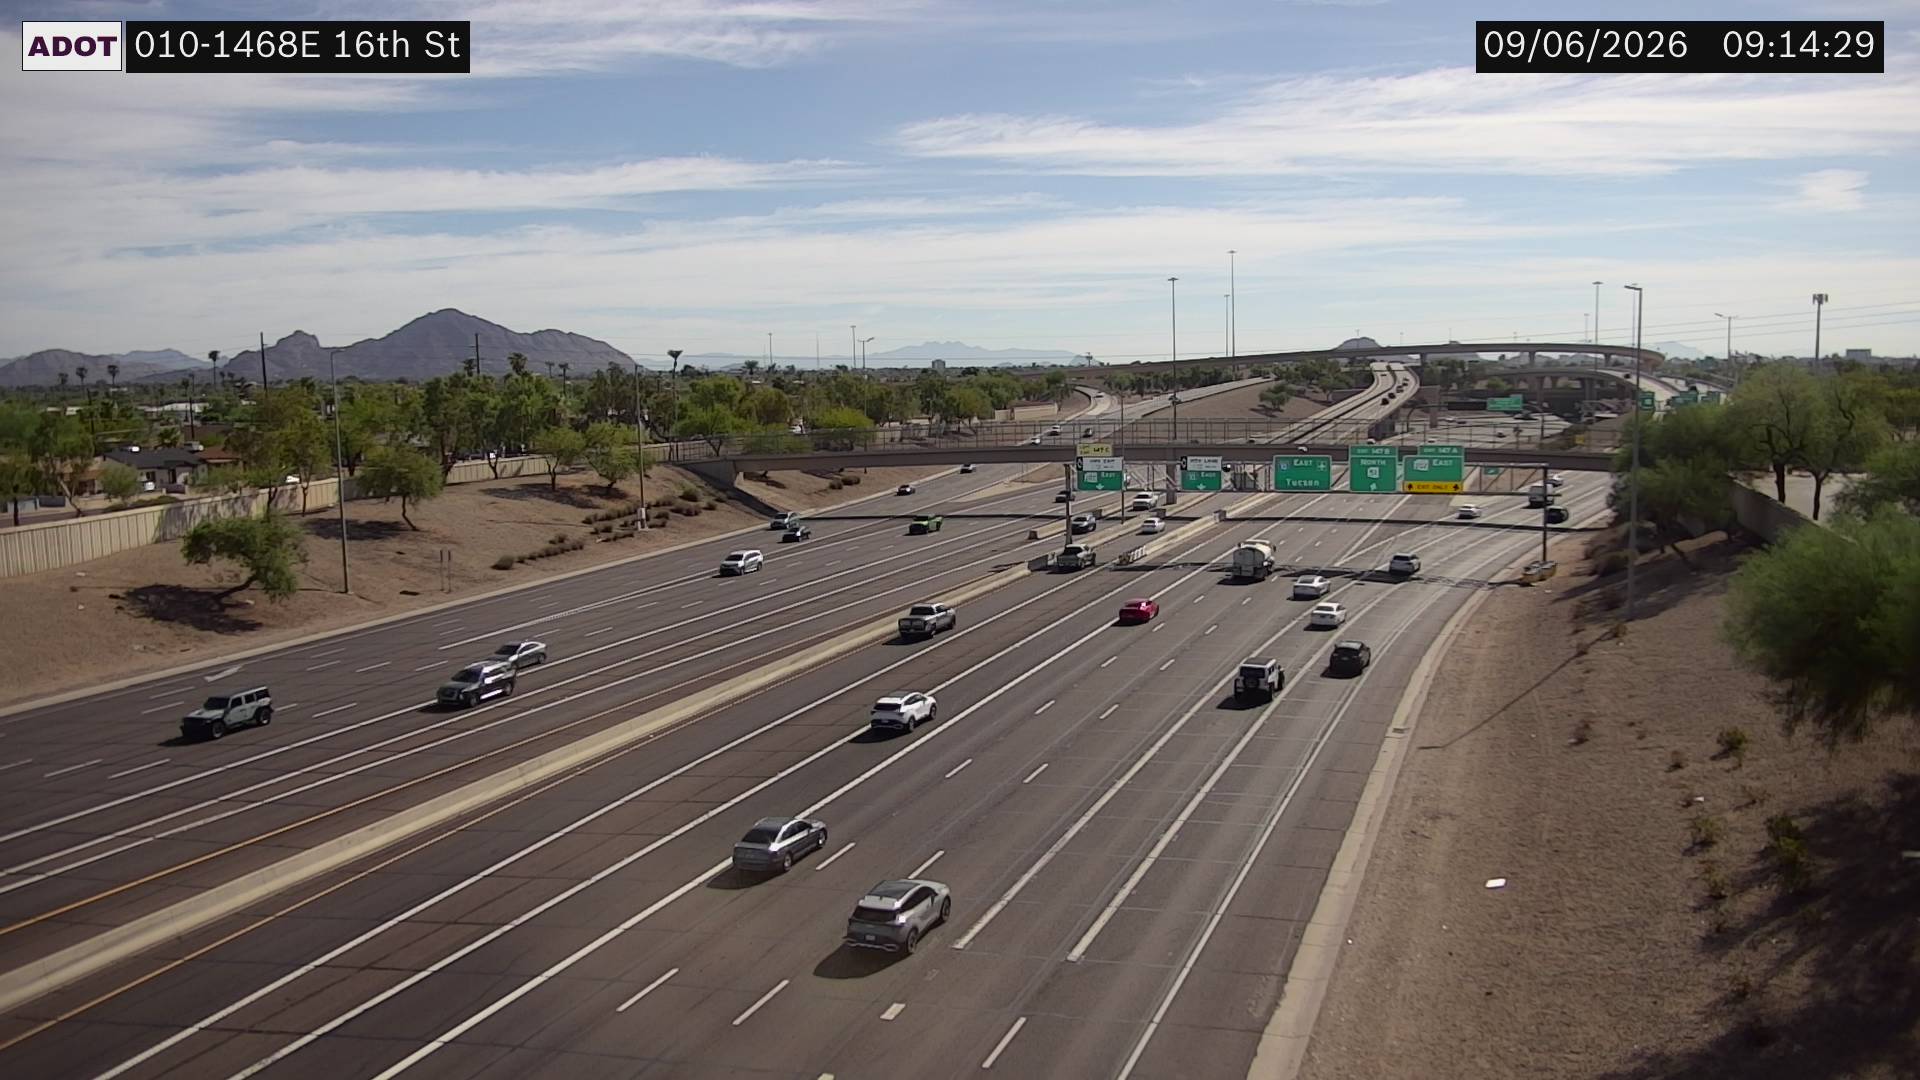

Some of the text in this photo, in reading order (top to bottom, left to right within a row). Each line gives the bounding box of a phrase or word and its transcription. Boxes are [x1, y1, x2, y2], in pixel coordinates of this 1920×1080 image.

[1293, 458, 1313, 466] EAST
[1432, 458, 1453, 466] EAST
[1286, 478, 1320, 487] Tucson
